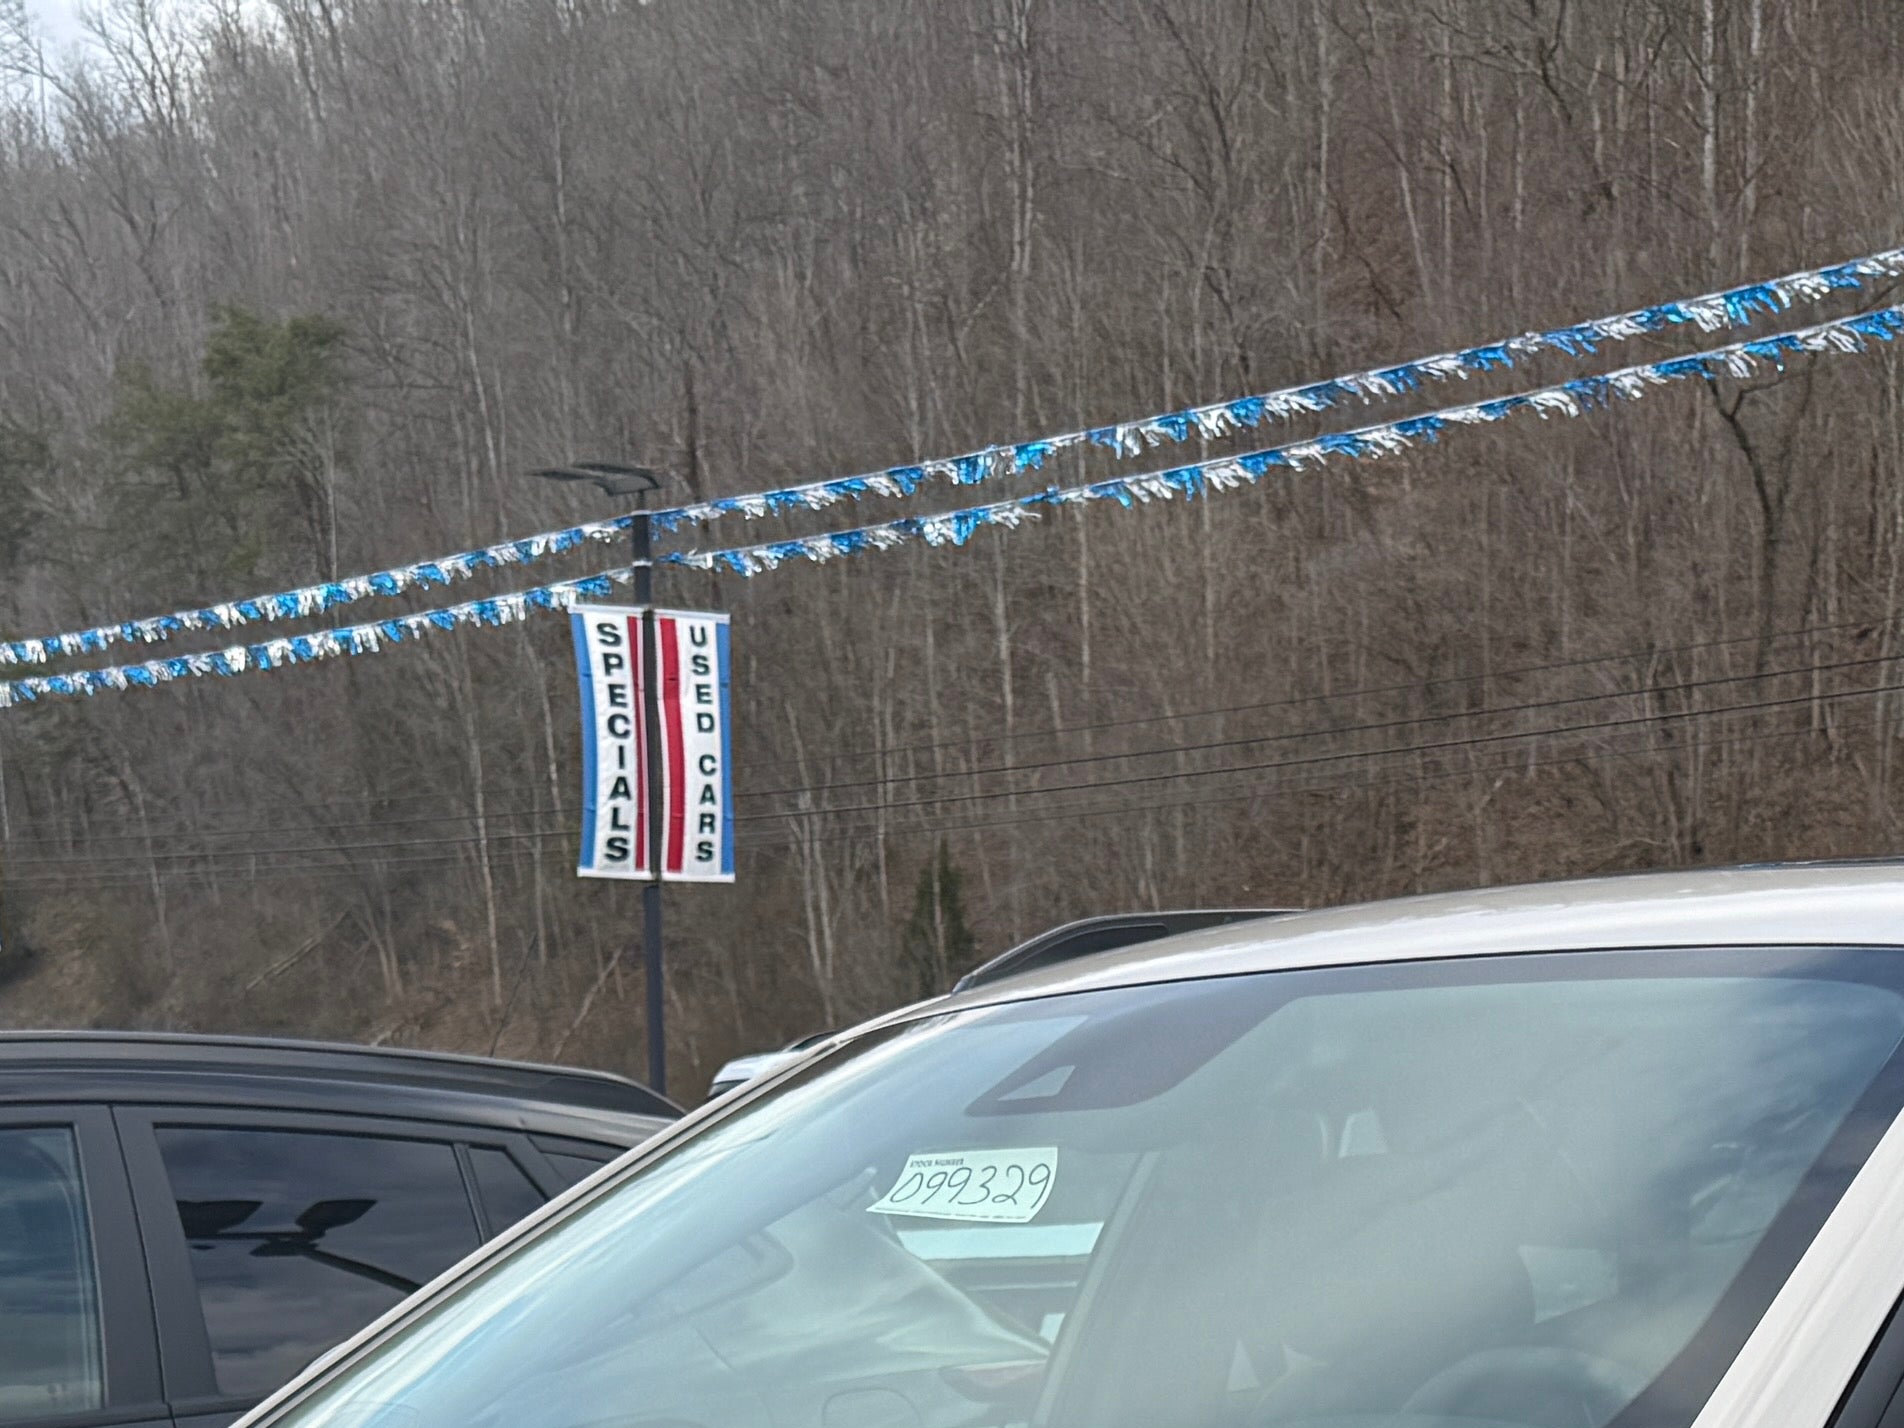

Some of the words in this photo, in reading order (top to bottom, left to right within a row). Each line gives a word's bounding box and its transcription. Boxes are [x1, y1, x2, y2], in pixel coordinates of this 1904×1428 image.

[689, 625, 715, 733] USED
[596, 622, 634, 862] SPECIALS
[695, 754, 717, 862] CARS
[889, 1162, 1052, 1209] 099329
